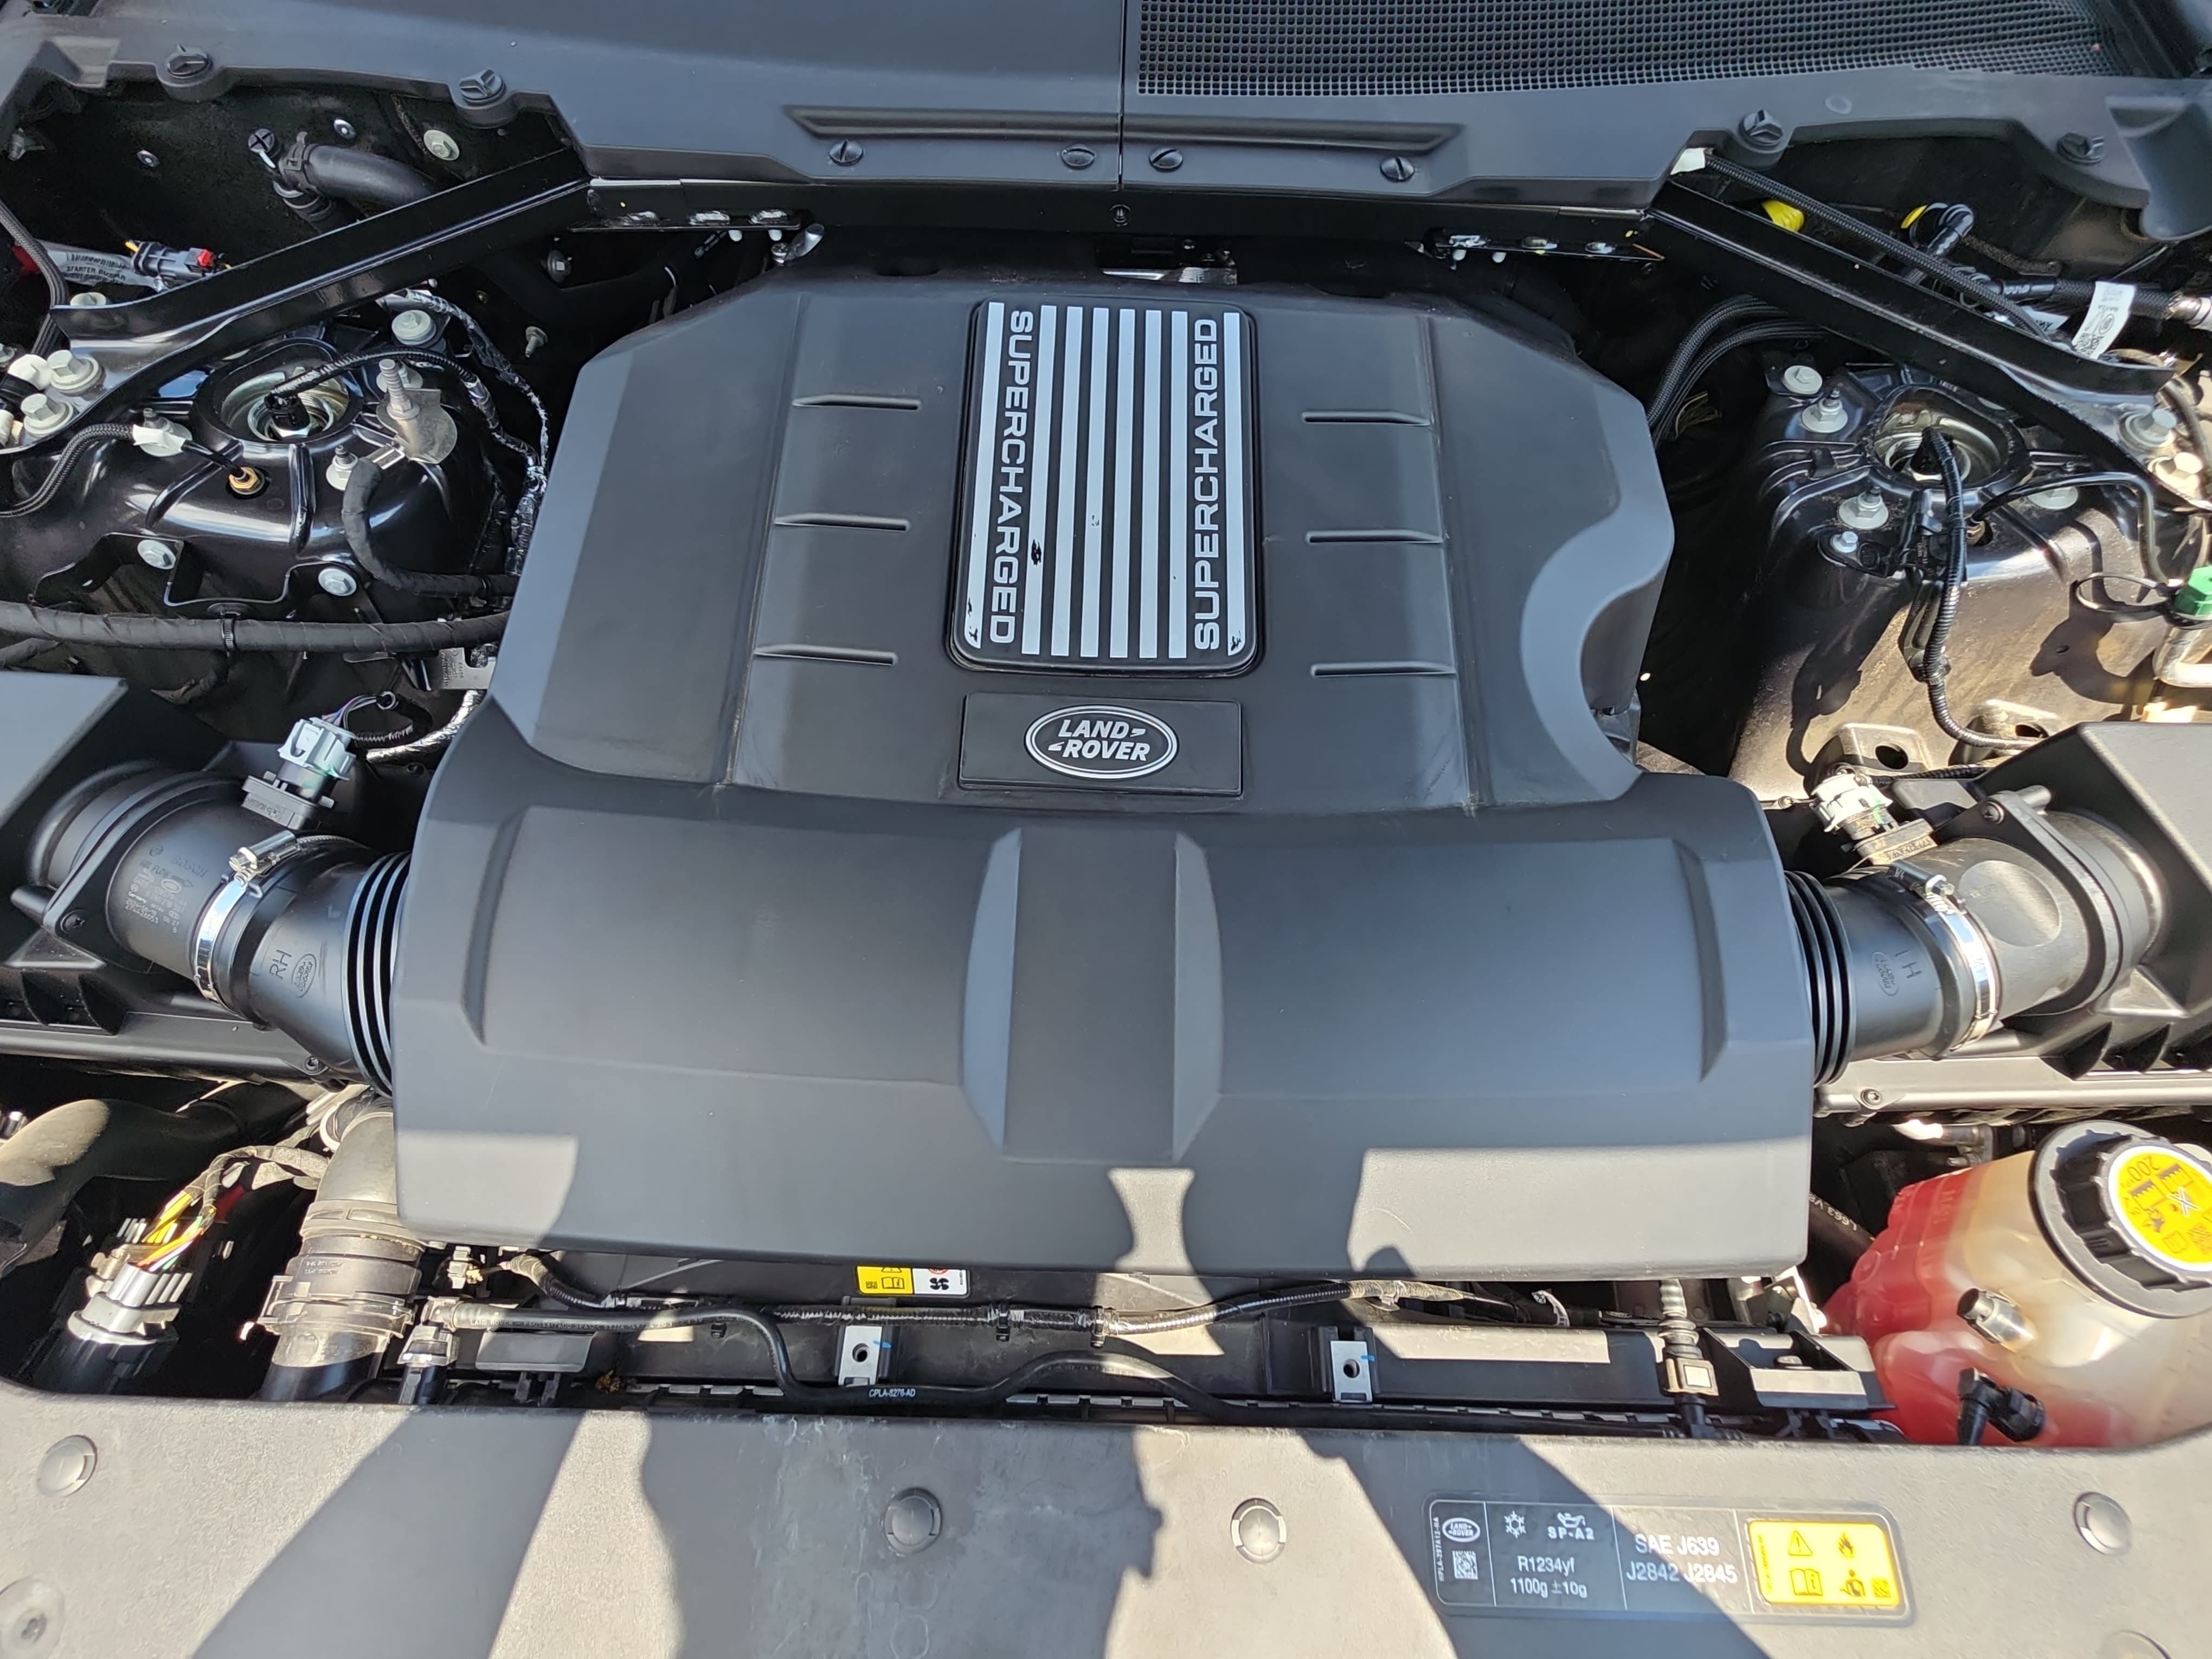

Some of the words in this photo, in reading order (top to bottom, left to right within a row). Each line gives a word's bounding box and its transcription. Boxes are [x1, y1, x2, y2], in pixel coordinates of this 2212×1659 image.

[67, 266, 96, 274] STARTER
[989, 310, 1033, 644] SUPERCHARGED
[1194, 318, 1219, 651] SUPERCHARGED
[1058, 719, 1130, 739] LAND
[1062, 740, 1150, 761] ROVER
[269, 949, 292, 980] RH
[1547, 1526, 1596, 1540] SP-A2
[1635, 1533, 1674, 1554] SAE
[1677, 1535, 1720, 1556] J639
[1517, 1555, 1576, 1577] R1234yf
[1626, 1561, 1680, 1582] J2842
[1683, 1561, 1738, 1584] J2845
[1510, 1577, 1549, 1599] 1100g
